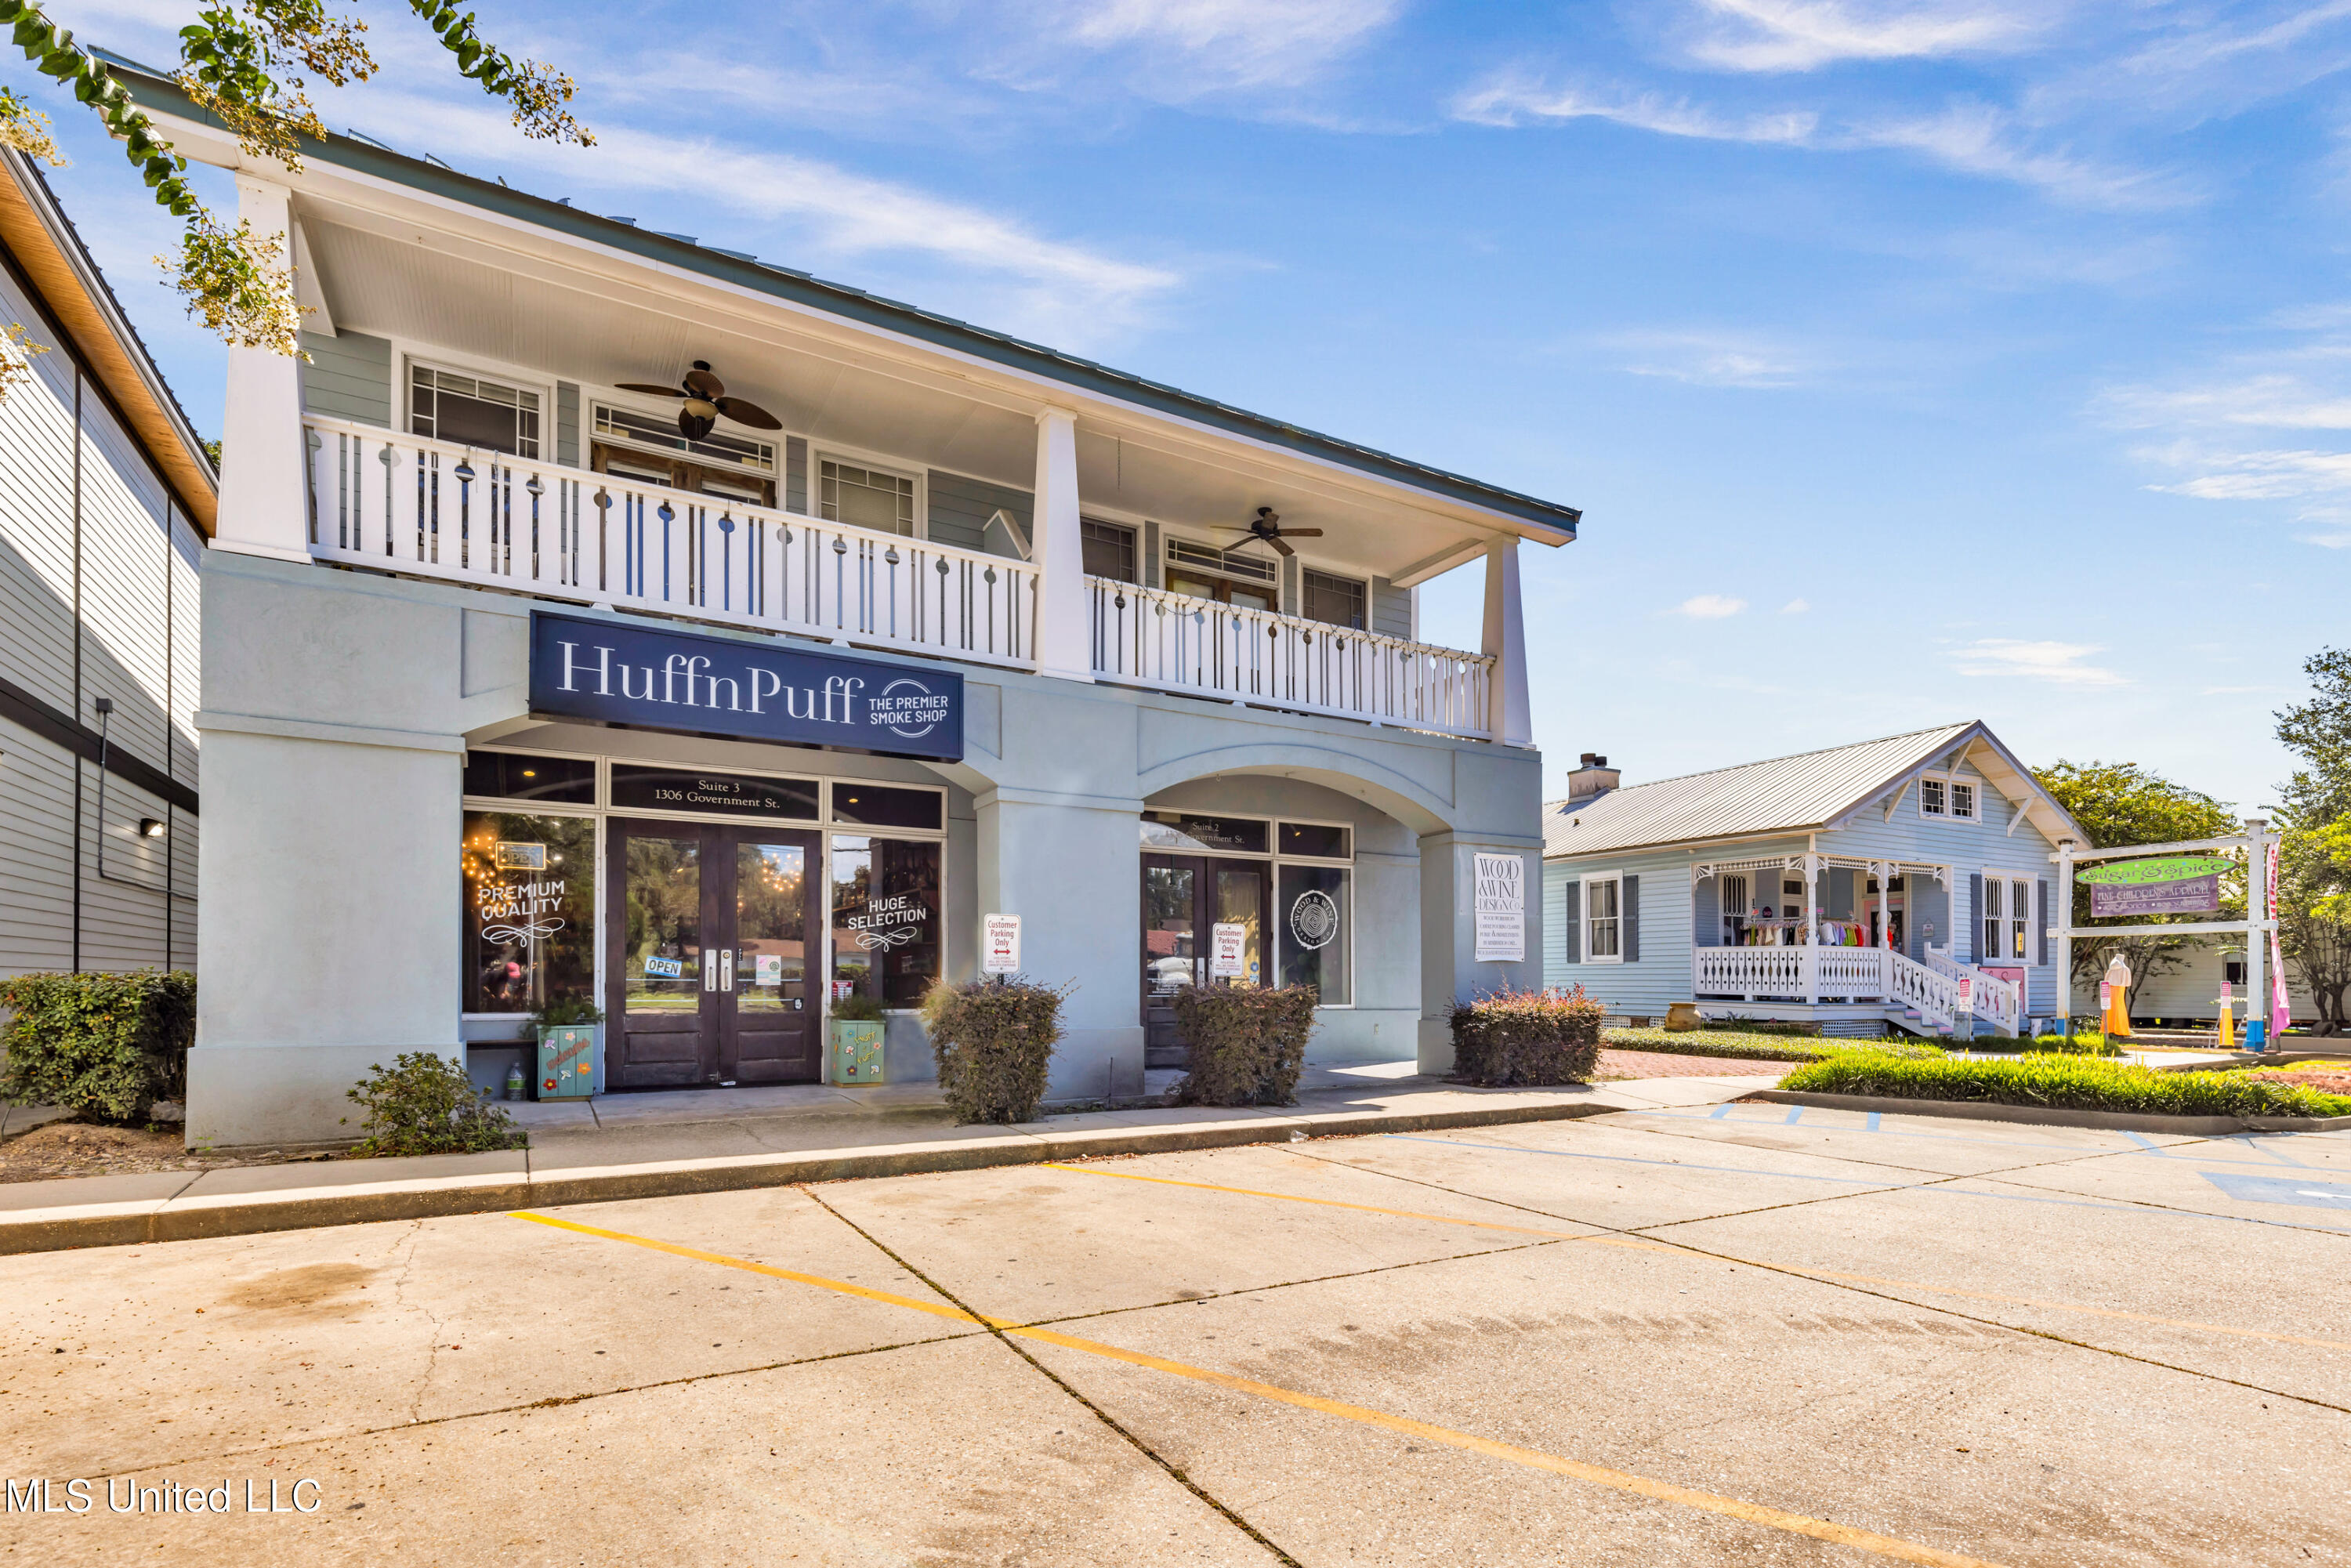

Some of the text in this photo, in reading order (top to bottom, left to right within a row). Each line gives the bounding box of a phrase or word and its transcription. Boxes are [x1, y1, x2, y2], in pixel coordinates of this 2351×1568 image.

[556, 641, 864, 725] HuffnPuff
[868, 696, 948, 710] THE PREMIER
[870, 710, 947, 725] SMOKE SHOP
[698, 780, 740, 792] Suite 3
[655, 789, 781, 808] 1306 Government St.
[1192, 822, 1219, 832] Suite 2
[1234, 835, 1245, 844] St.
[1479, 858, 1519, 880] WOOD
[2086, 864, 2224, 882] Sugar & Spice
[479, 880, 564, 904] PREMIUM
[481, 897, 563, 922] QUALITY
[869, 896, 907, 913] HUGE
[1294, 897, 1311, 922] WOOD
[847, 907, 926, 930] SELECTION
[987, 920, 1017, 929] Customer
[991, 929, 1014, 940] Parking
[1218, 936, 1239, 947] Parking
[994, 938, 1009, 948] Only
[1223, 944, 1235, 954] Only
[648, 958, 679, 975] OPEN
